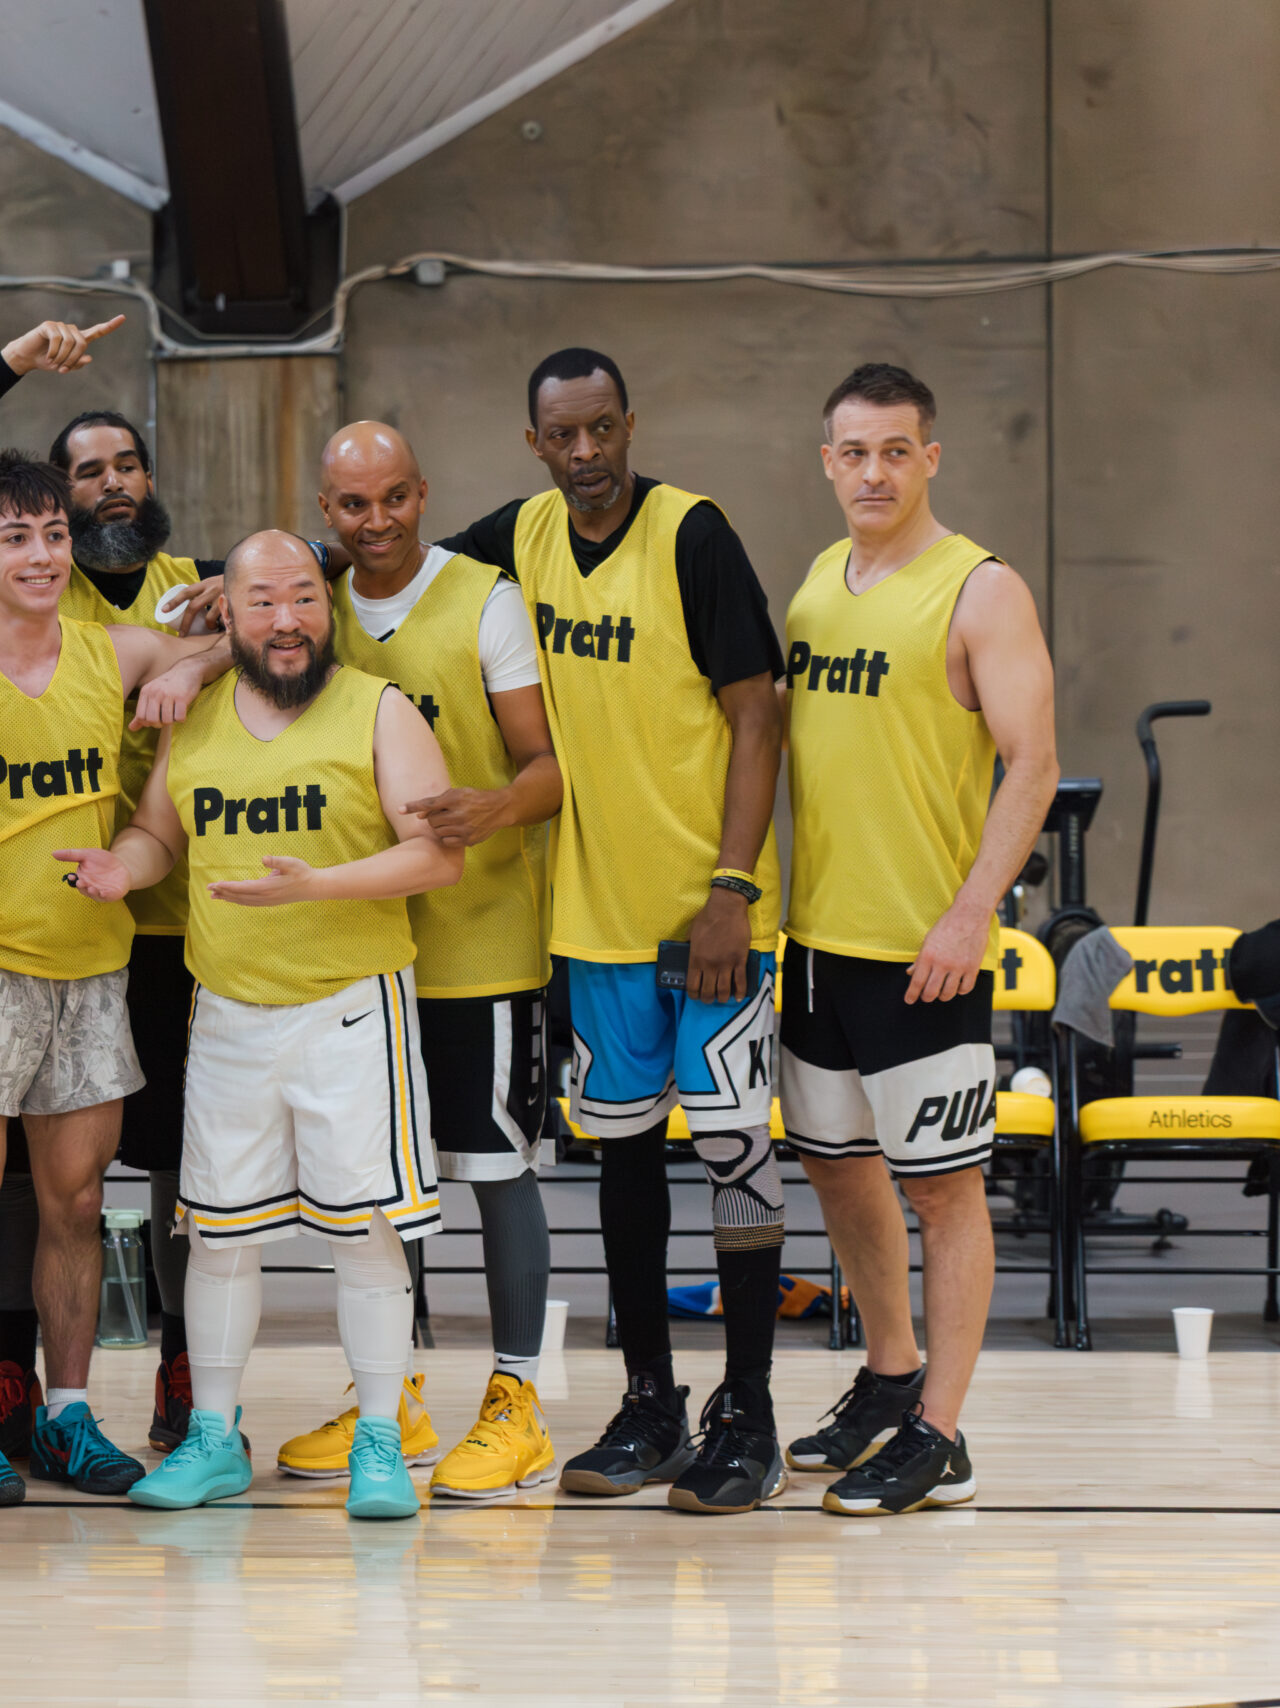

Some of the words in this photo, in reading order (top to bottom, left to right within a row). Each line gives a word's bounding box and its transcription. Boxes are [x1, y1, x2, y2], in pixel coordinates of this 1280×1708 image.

[536, 602, 635, 663] Pratt
[786, 641, 890, 697] Pratt
[193, 784, 327, 837] Pratt
[1134, 949, 1235, 994] rat
[1149, 1109, 1233, 1128] Athletics
